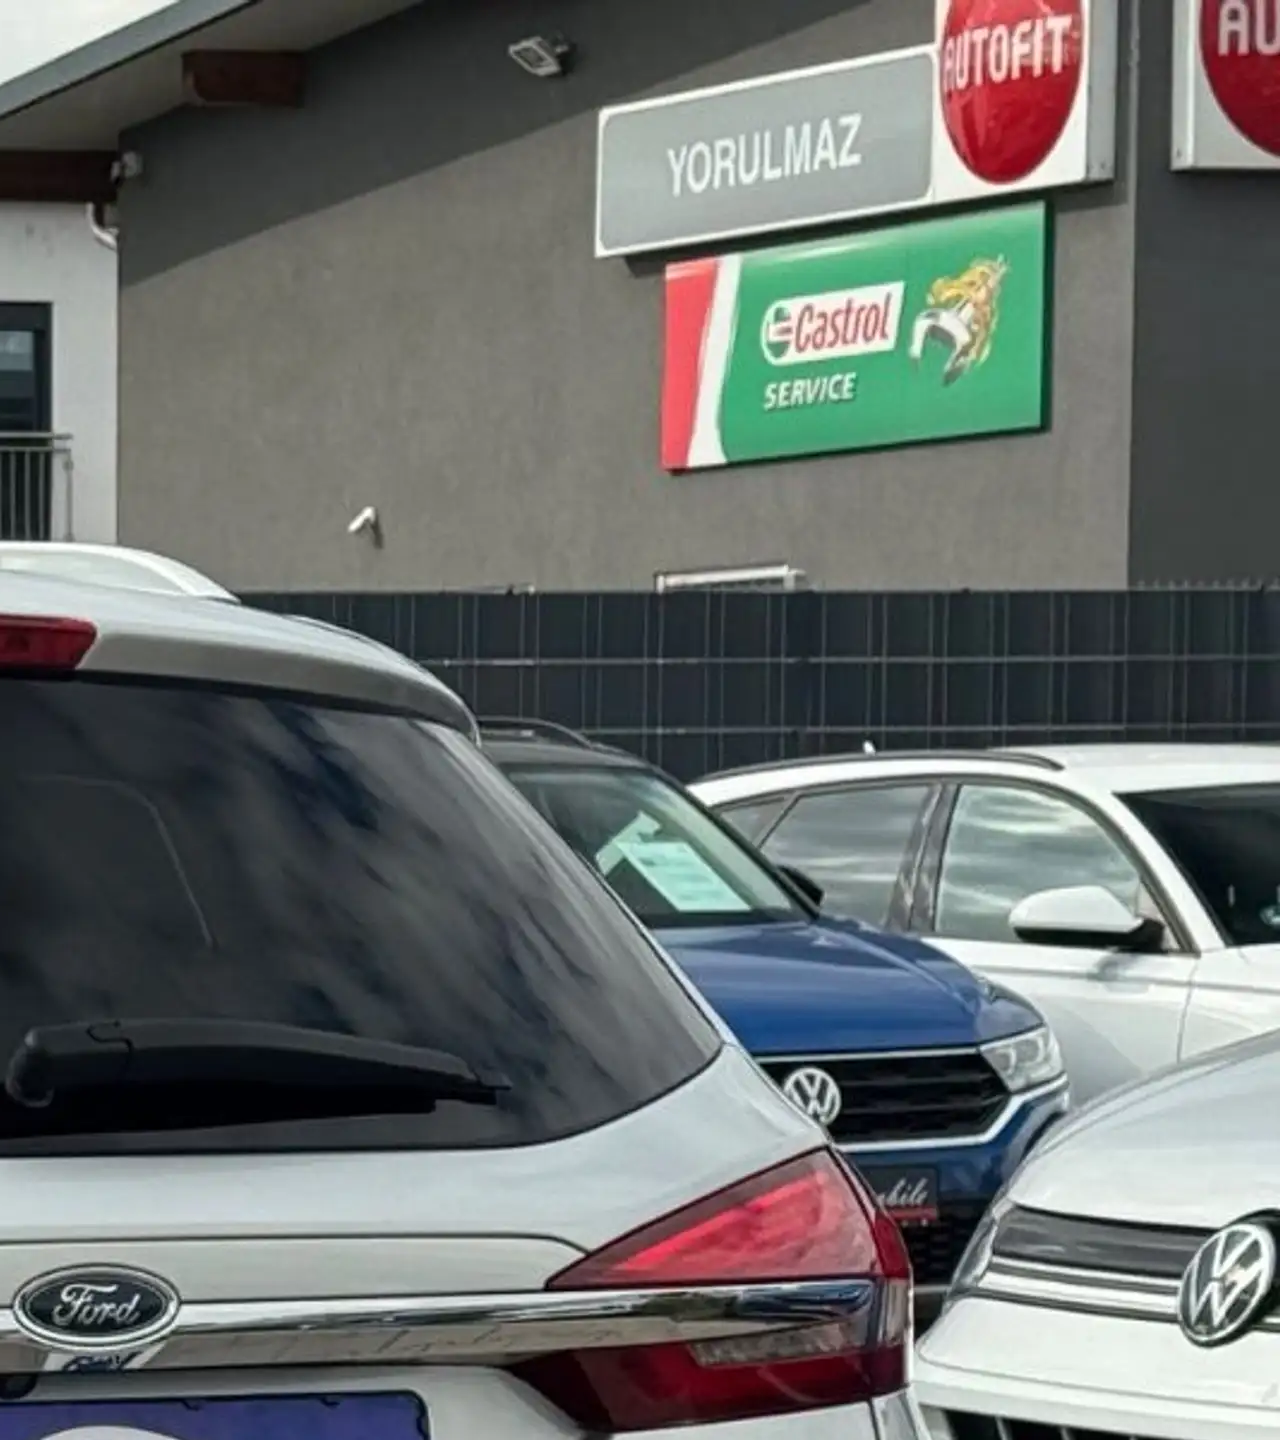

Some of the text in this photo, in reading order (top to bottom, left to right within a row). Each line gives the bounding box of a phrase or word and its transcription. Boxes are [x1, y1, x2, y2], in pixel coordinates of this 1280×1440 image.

[942, 14, 1073, 93] AUTOFIT
[666, 112, 862, 198] YORULMAZ
[794, 290, 893, 354] Castrol
[763, 371, 857, 412] SERVICE
[50, 1282, 142, 1327] Ford
